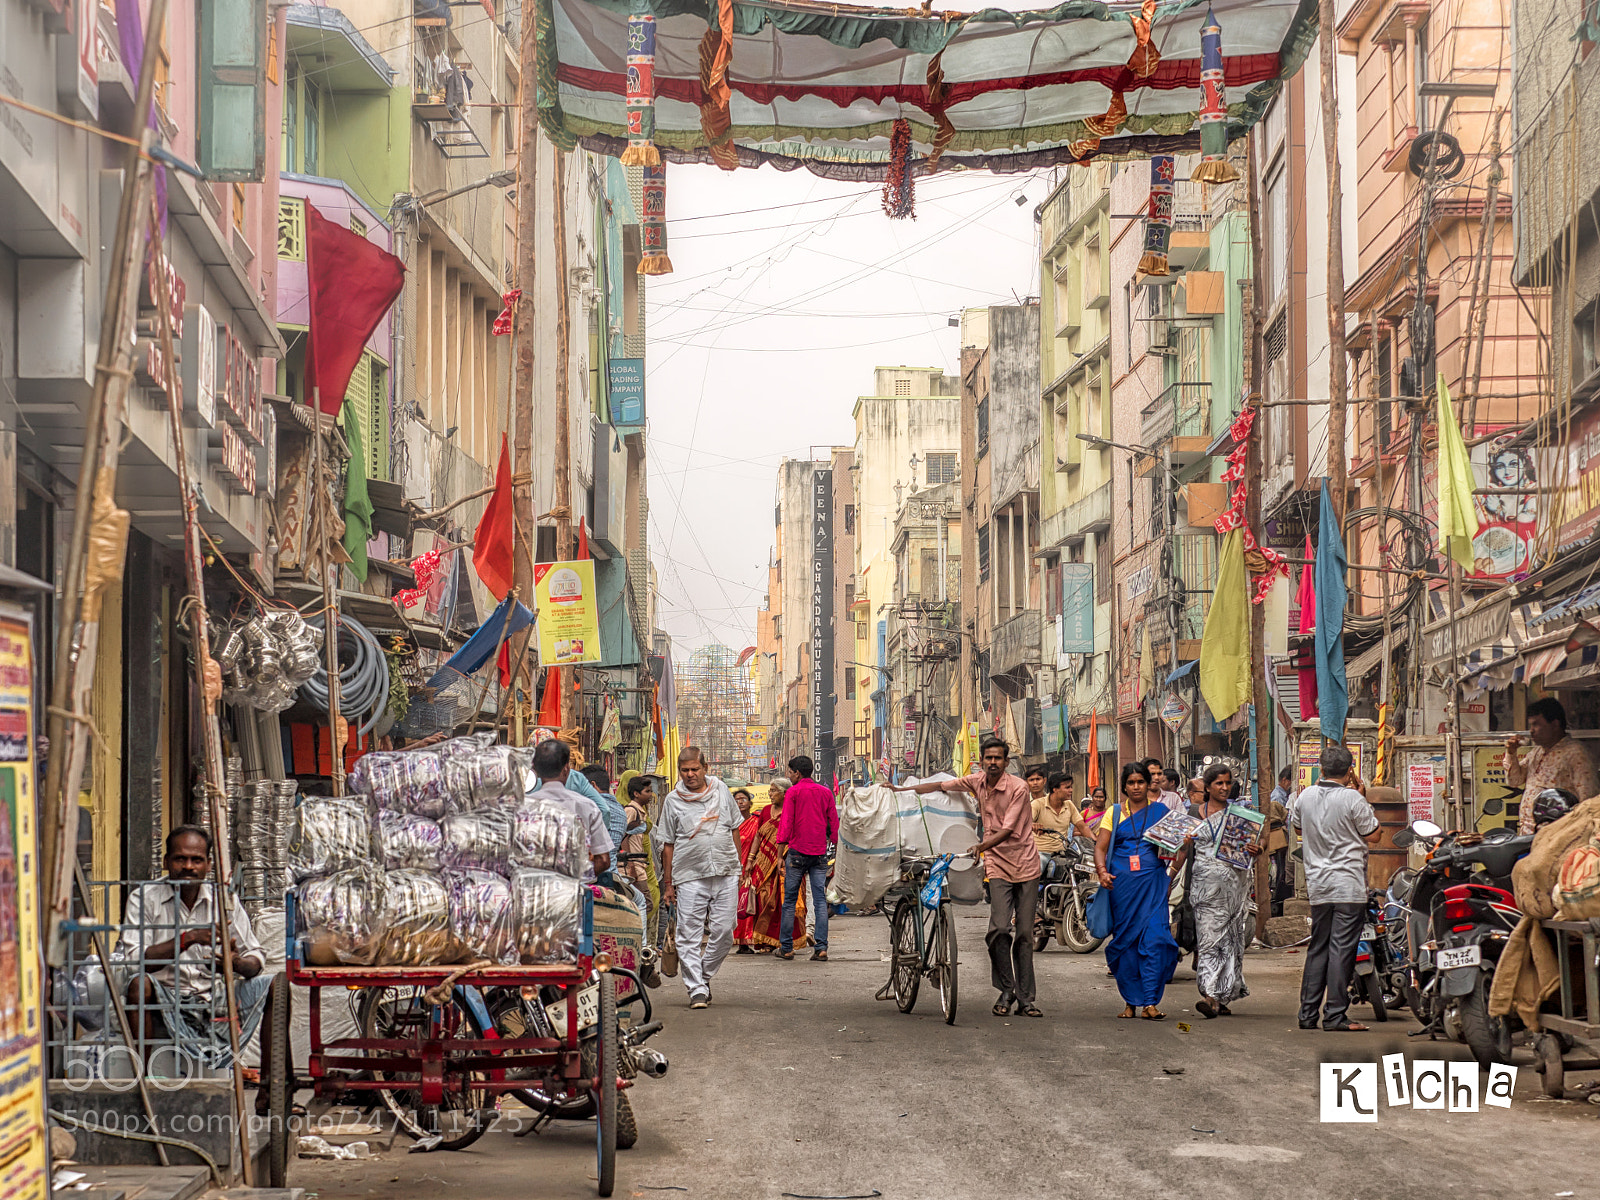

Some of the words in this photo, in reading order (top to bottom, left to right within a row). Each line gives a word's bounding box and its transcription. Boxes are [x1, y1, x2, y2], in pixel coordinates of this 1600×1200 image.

[610, 376, 640, 384] RADING
[816, 471, 827, 536] VEENA
[814, 562, 822, 692] CHANDRAMUKHI
[1444, 619, 1468, 654] BAAJI
[1456, 957, 1474, 965] 1104
[580, 994, 591, 1005] 01
